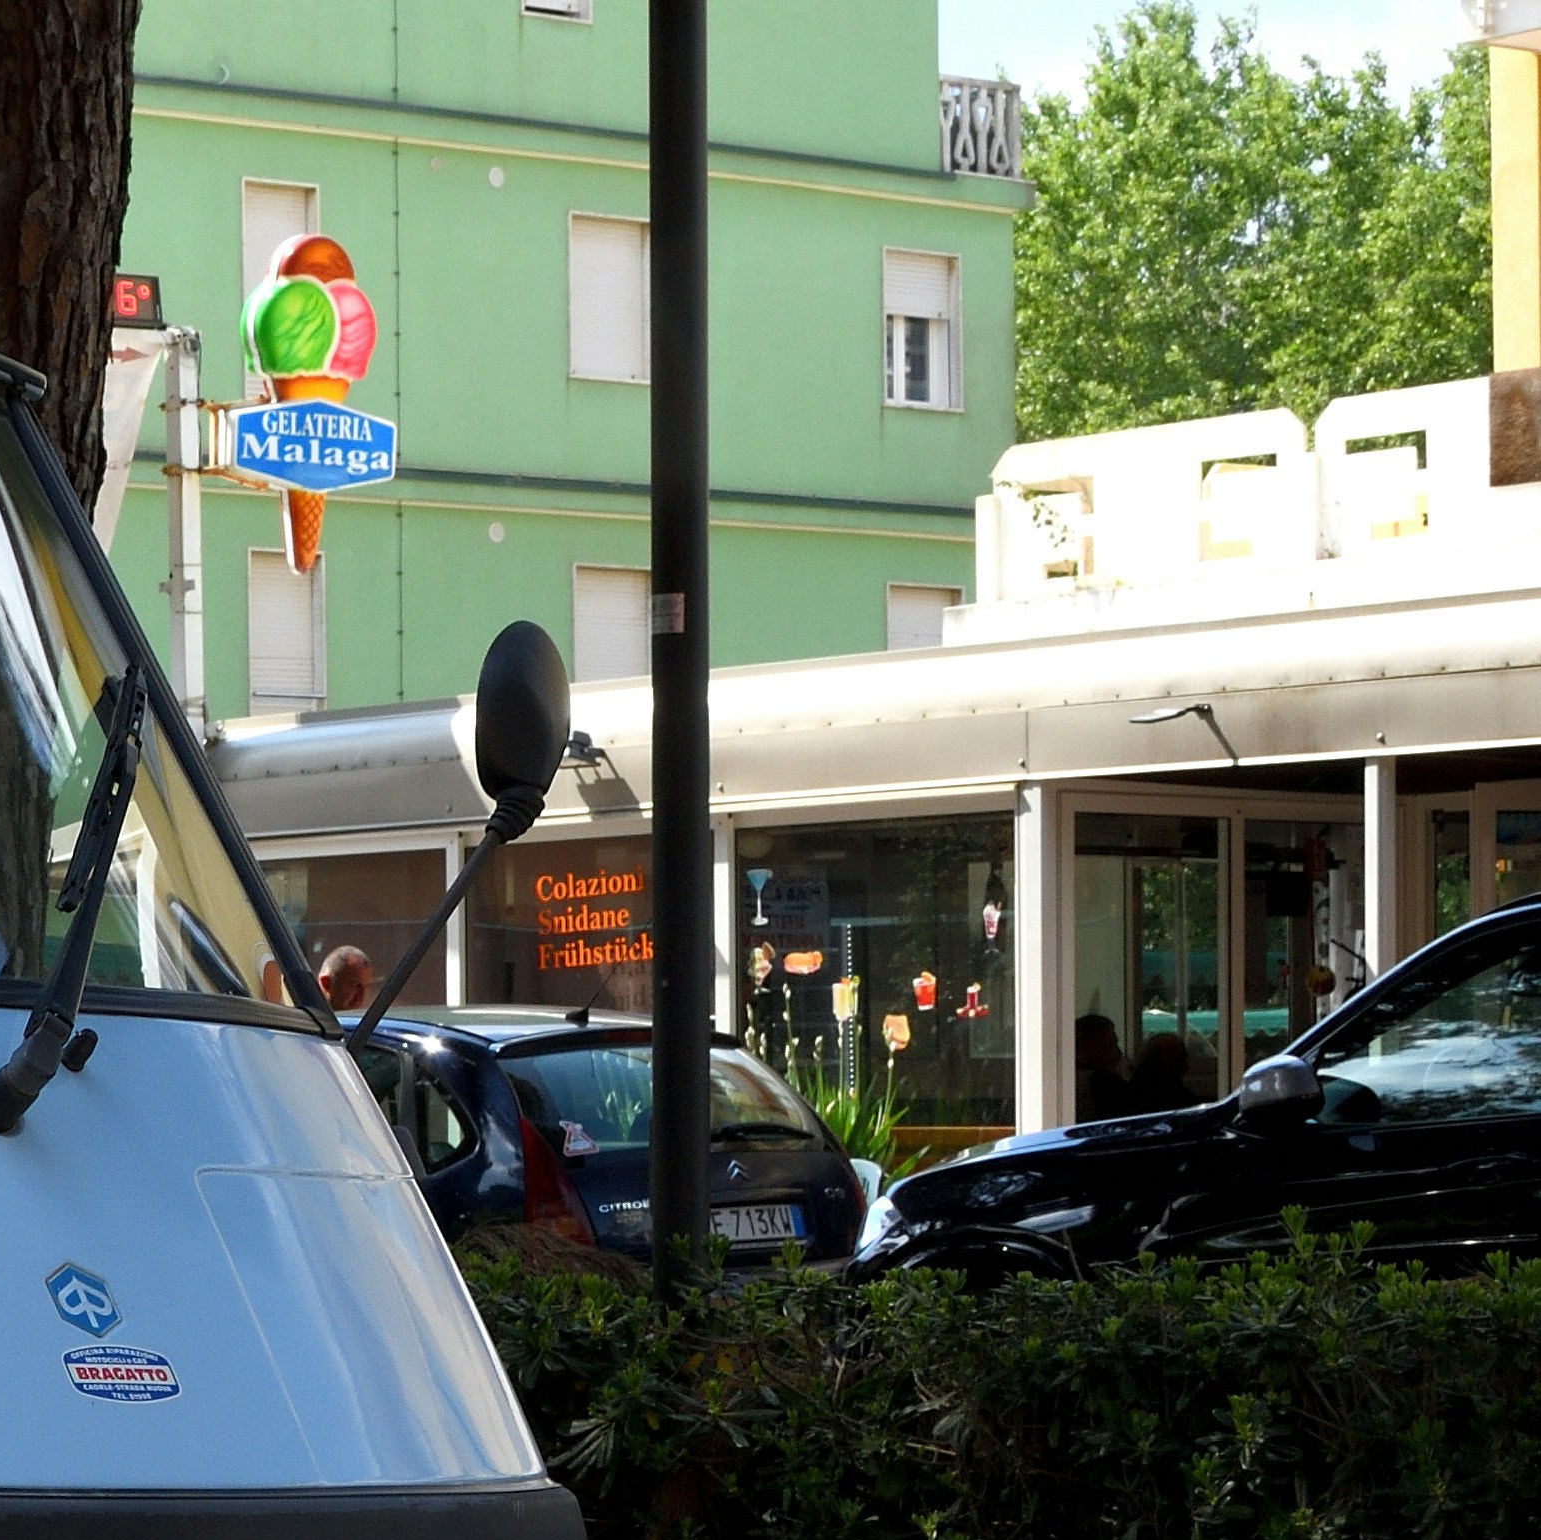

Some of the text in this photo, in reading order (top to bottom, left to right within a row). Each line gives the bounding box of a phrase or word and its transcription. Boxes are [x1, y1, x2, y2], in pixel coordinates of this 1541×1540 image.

[262, 409, 373, 442] GELATERIA
[241, 433, 391, 475] Malaga
[536, 865, 644, 902] Colazioni
[538, 904, 630, 936] Snidane
[538, 933, 655, 971] Frühstück
[75, 1367, 168, 1382] BRAGATTO
